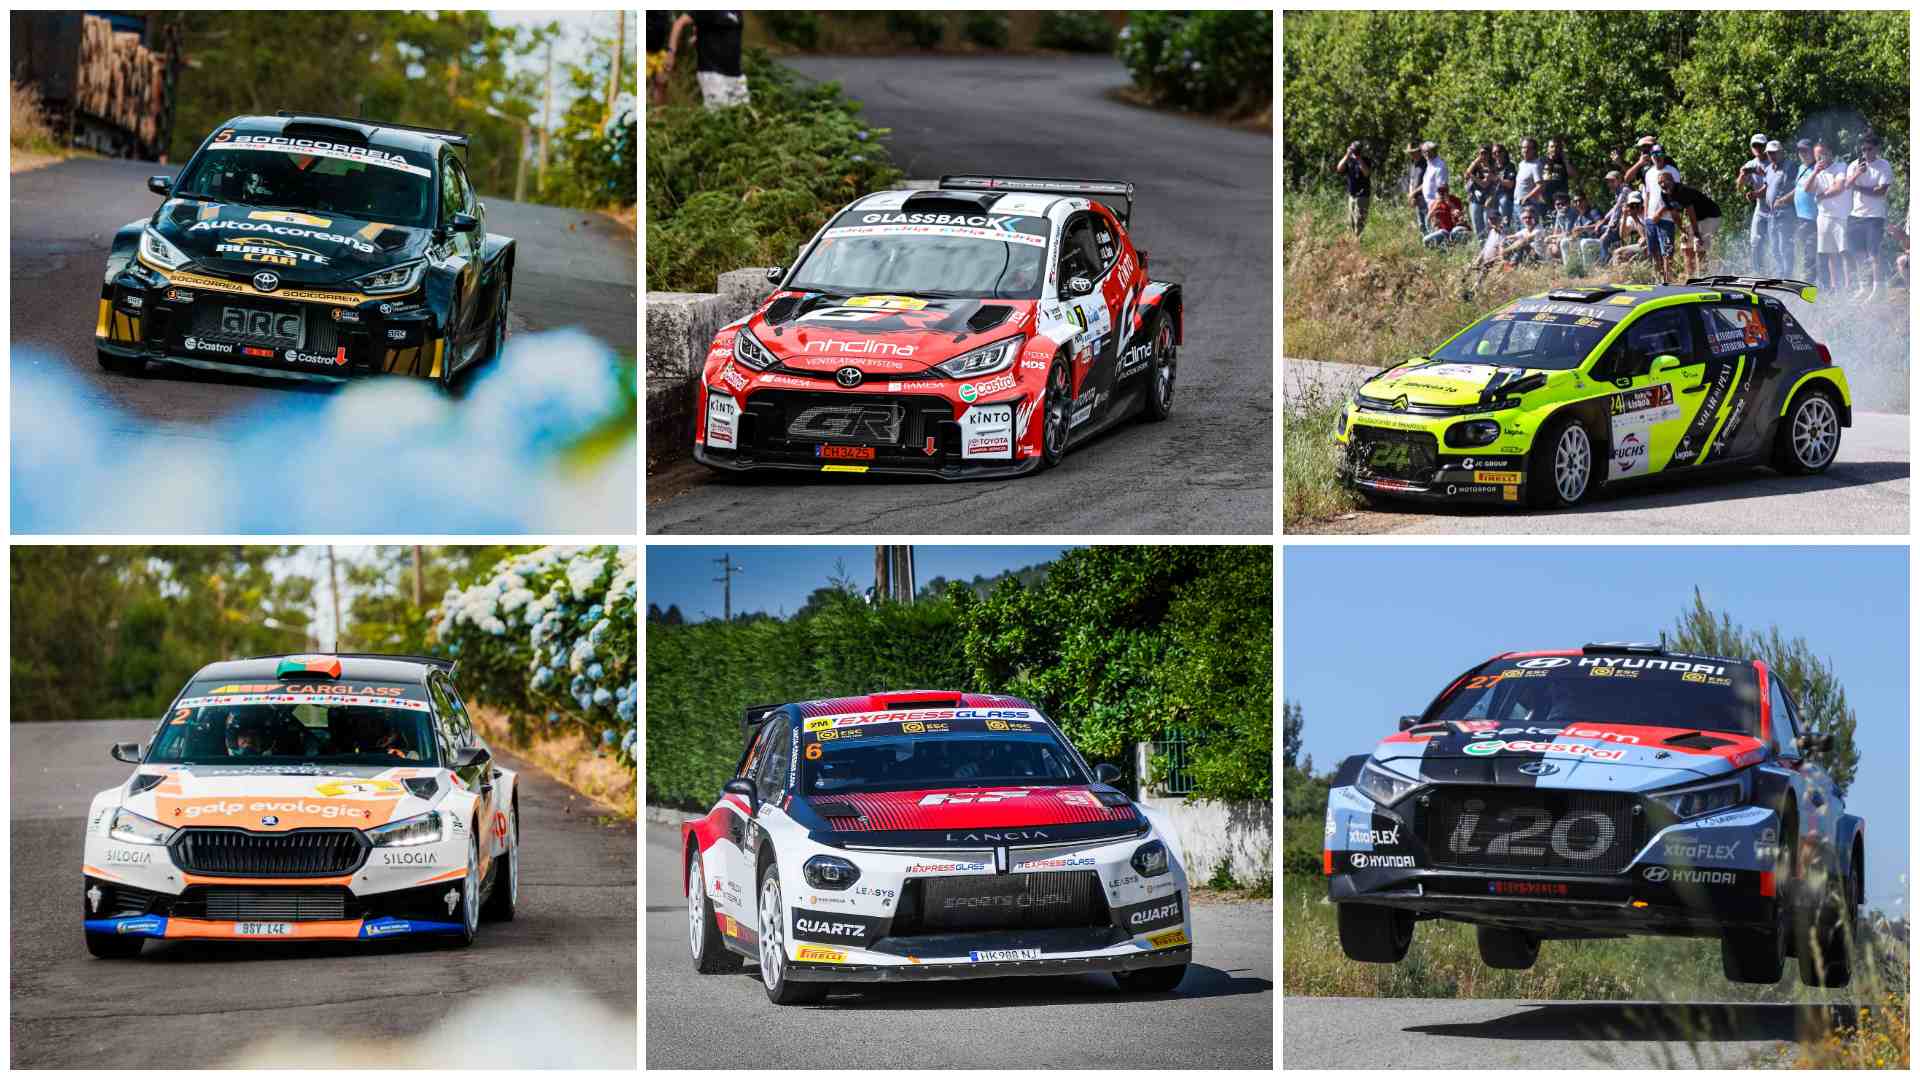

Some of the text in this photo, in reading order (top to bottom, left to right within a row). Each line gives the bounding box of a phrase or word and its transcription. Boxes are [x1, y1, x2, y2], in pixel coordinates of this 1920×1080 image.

[214, 129, 236, 142] 5
[234, 135, 408, 164] SOCICORREIA
[862, 213, 1011, 231] GLASSBACK
[253, 253, 306, 266] CAR
[170, 274, 243, 291] SOCICORREIA
[282, 289, 361, 303] SOCICORREIA
[196, 338, 233, 352] Castrol
[803, 338, 915, 356] nhclima
[298, 350, 337, 365] Castrol
[1021, 360, 1047, 369] MDS
[976, 372, 1017, 395] Castrol
[1578, 657, 1726, 676] HYUNDAI
[285, 684, 403, 696] CARGLASS
[1465, 675, 1503, 690] 27
[170, 708, 192, 725] 2
[805, 743, 822, 760] 6
[1506, 741, 1627, 761] Castrol
[185, 801, 358, 818] galp evologic
[946, 831, 1049, 842] LANCIA
[1349, 824, 1400, 846] xtraFLEX
[1448, 800, 1617, 860] i20
[107, 849, 152, 864] SILOGIA
[384, 852, 438, 865] SILOGIA
[1663, 840, 1741, 860] xtraFLEX
[1369, 855, 1416, 868] HYUNDAI
[1672, 869, 1737, 885] HYUNDAI
[855, 887, 896, 898] LEASYS
[1130, 901, 1180, 925] QUARTZ
[796, 918, 867, 938] QUARTZ
[799, 948, 844, 961] PIRELLI
